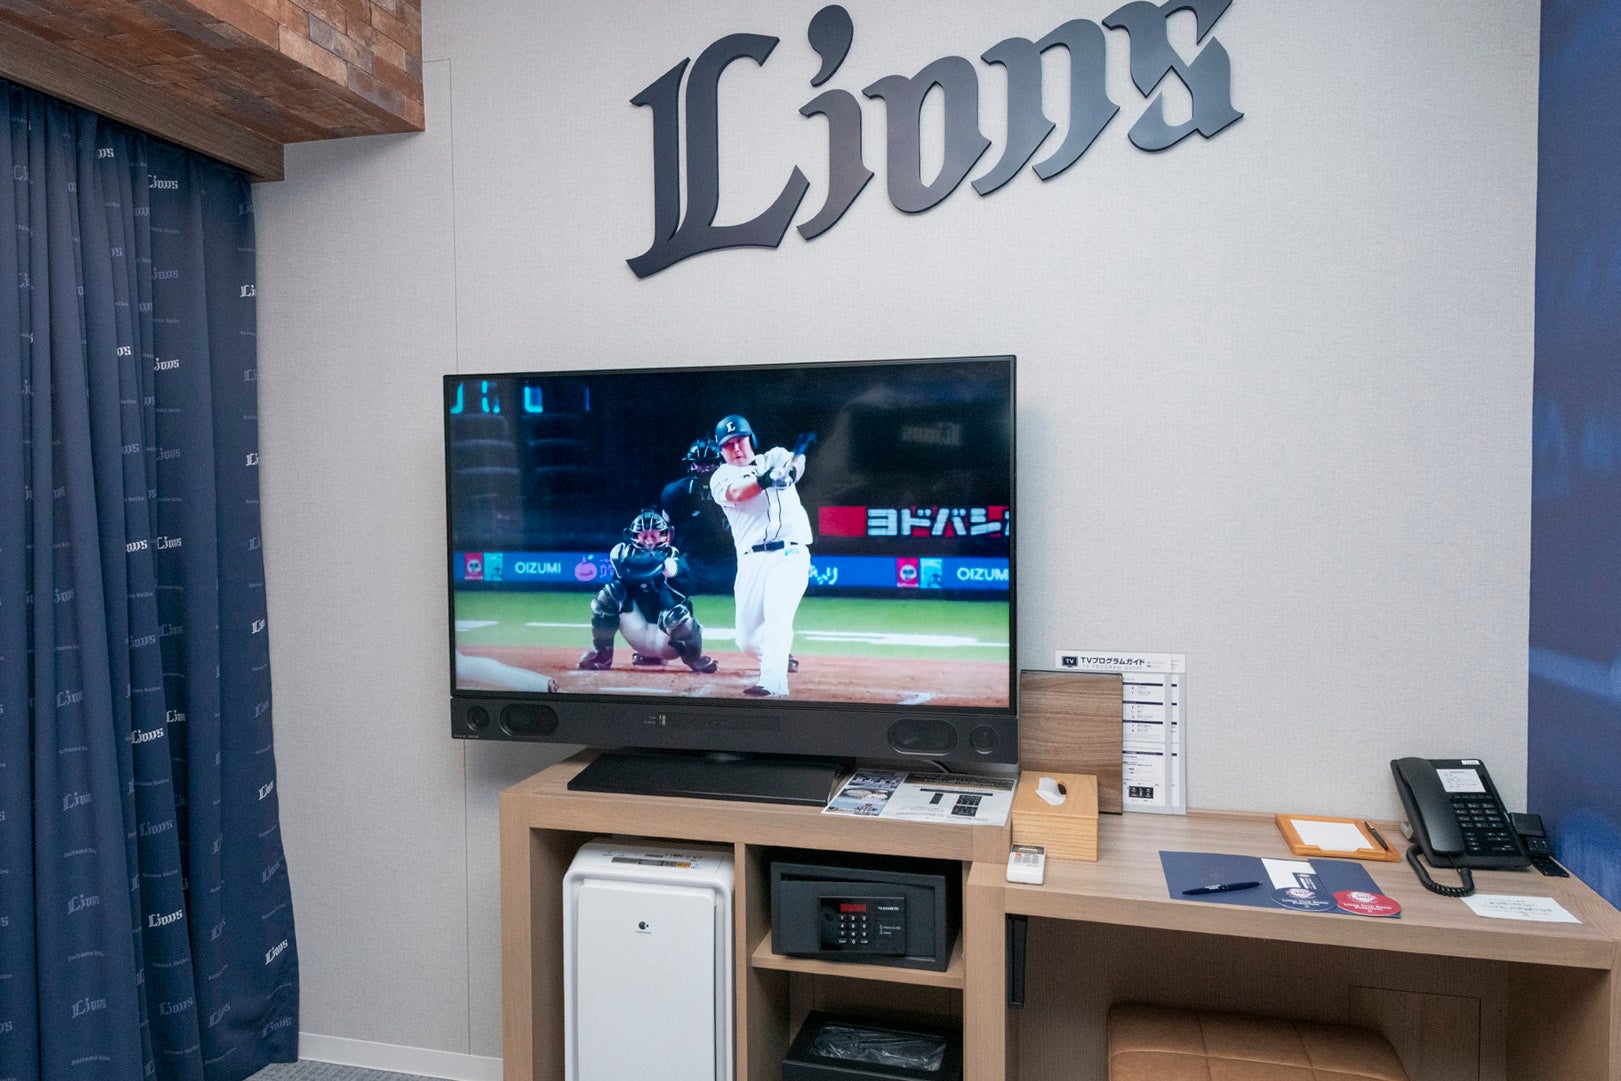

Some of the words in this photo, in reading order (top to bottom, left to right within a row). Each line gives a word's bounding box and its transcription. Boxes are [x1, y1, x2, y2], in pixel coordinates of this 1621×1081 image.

[626, 0, 1244, 279] Lions
[152, 267, 179, 281] ions
[154, 357, 180, 371] ions
[867, 507, 1010, 536] ヨドバシ
[515, 561, 562, 574] OIZUMI
[957, 567, 1010, 581] OIZUM
[1080, 656, 1146, 666] TVプログラムガイド
[131, 726, 165, 744] Lions
[148, 909, 184, 928] Lions
[265, 938, 289, 965] Lions
